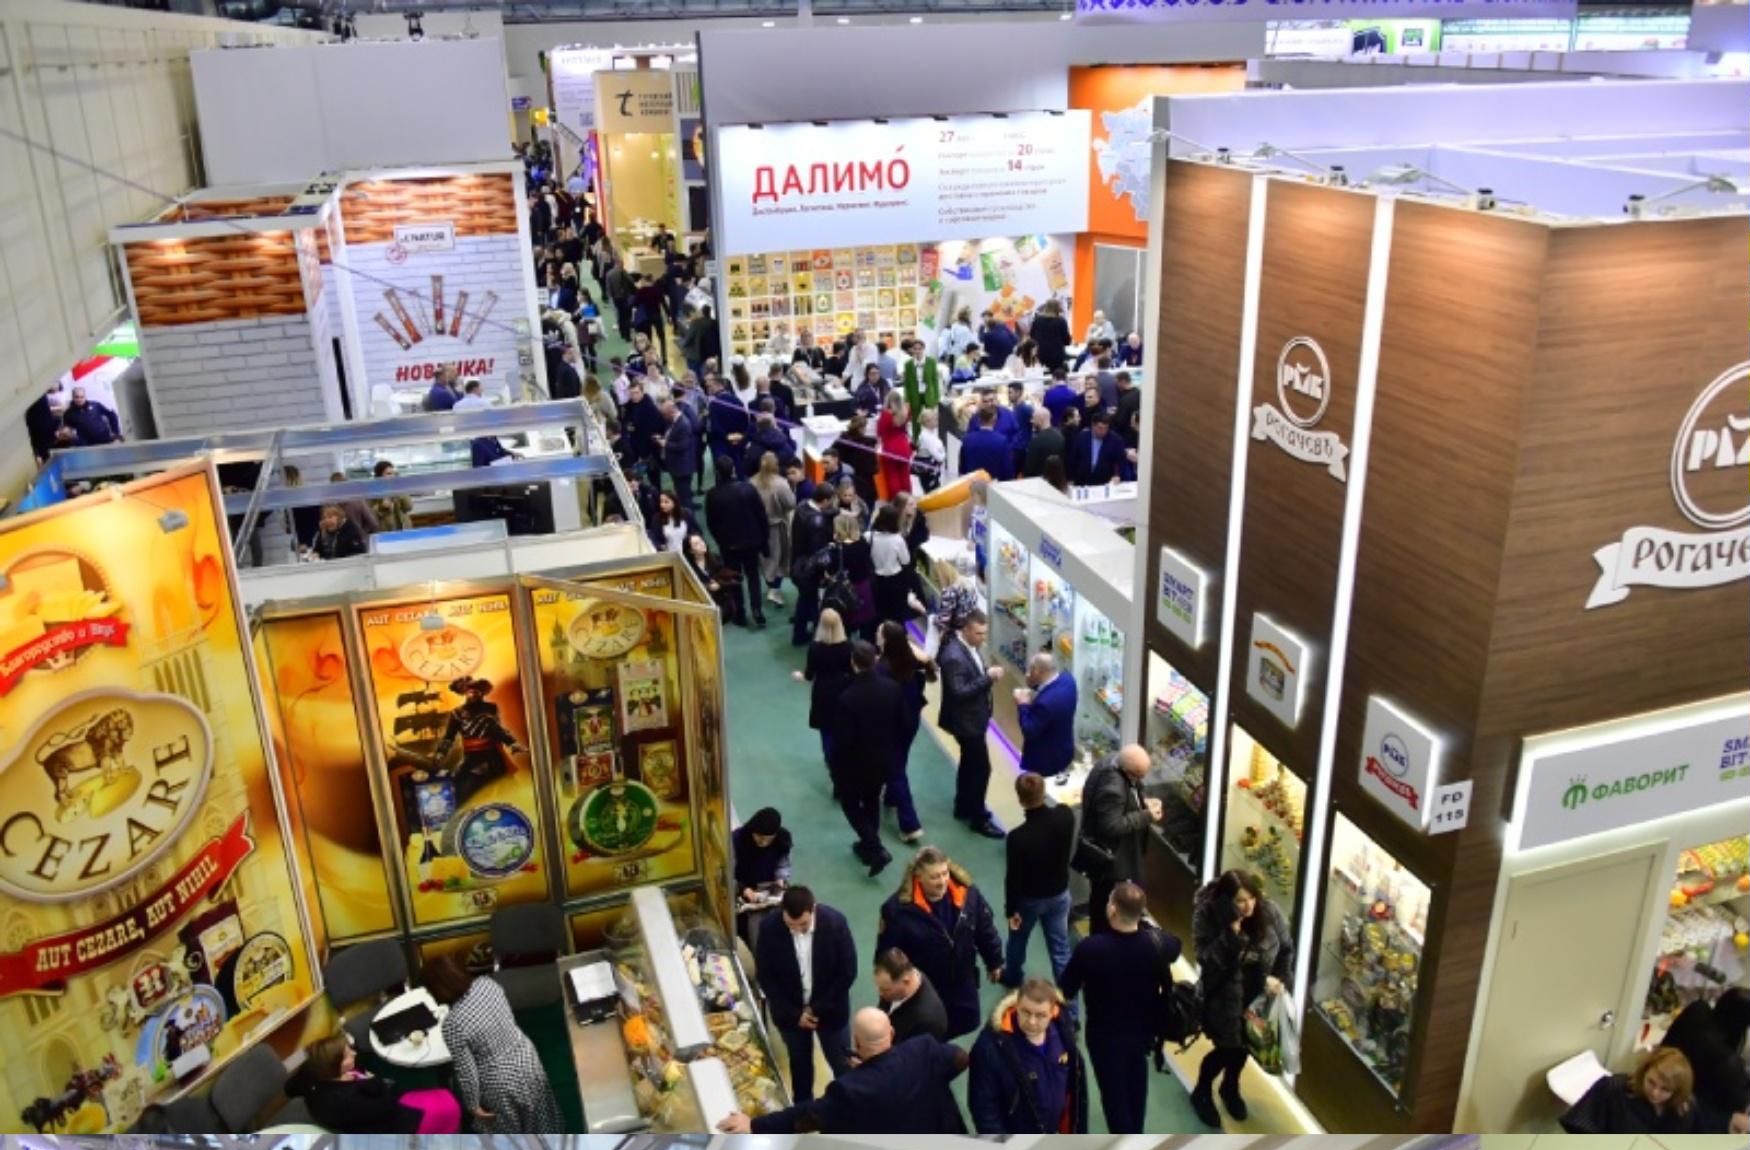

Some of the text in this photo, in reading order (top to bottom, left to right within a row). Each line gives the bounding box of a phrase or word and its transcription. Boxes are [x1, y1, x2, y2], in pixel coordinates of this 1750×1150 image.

[939, 131, 955, 143] 27
[396, 358, 495, 382] НОВКА!
[1591, 764, 1690, 801] ФАВОРИТ
[0, 734, 193, 884] CEZARE
[1441, 791, 1463, 805] FD
[35, 854, 221, 973] AUT CEZARE, AUT NIHIL
